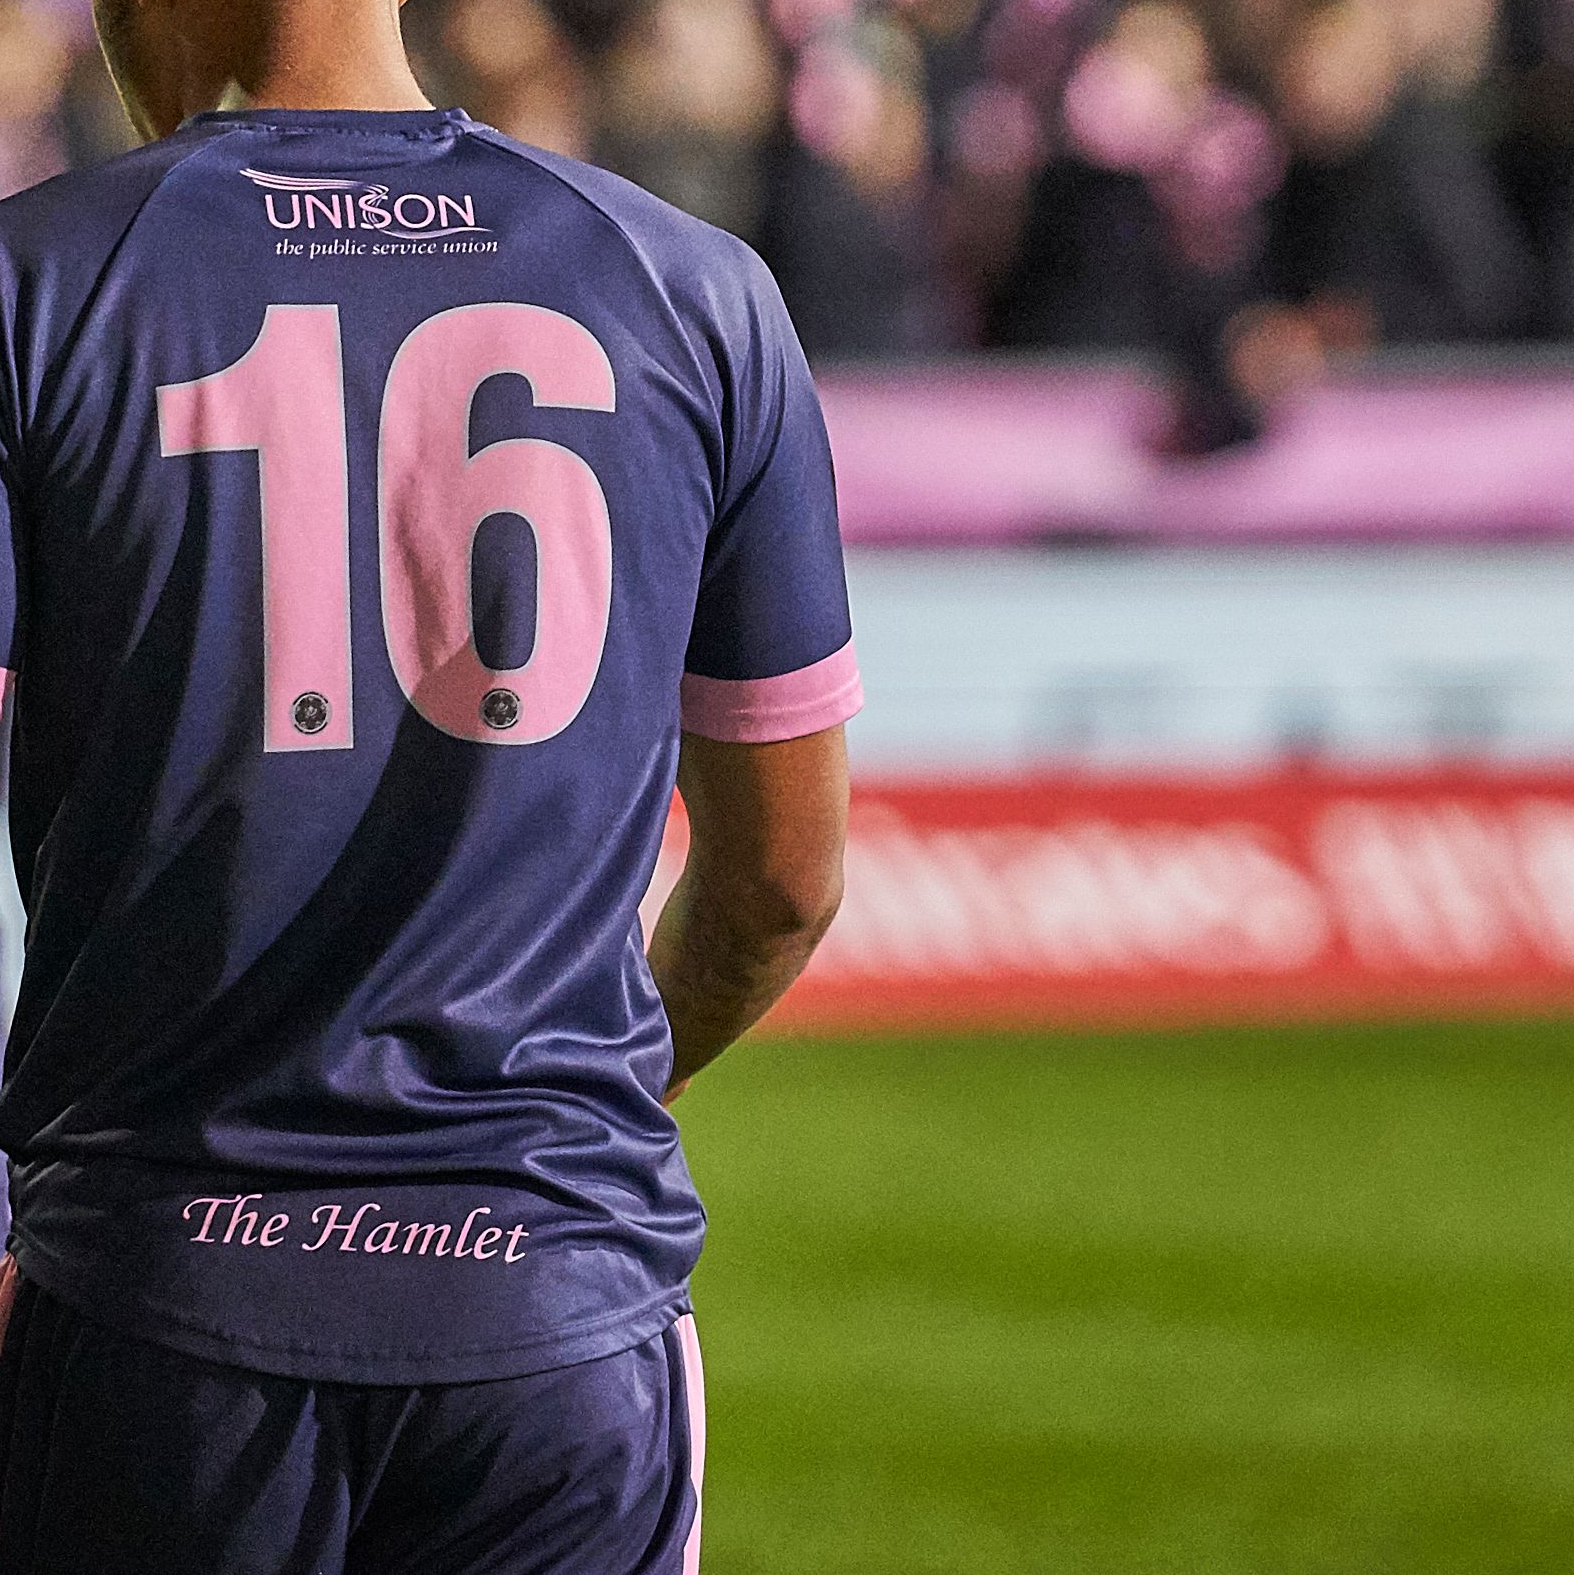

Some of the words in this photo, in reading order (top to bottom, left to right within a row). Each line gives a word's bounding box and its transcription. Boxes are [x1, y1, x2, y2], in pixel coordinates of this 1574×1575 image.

[264, 189, 476, 230] UNISON
[275, 238, 304, 256] the
[309, 238, 367, 260] public
[371, 240, 438, 256] service
[442, 236, 499, 254] union
[156, 302, 617, 753] 16
[182, 1193, 290, 1248] The
[301, 1202, 531, 1265] Hamlet
